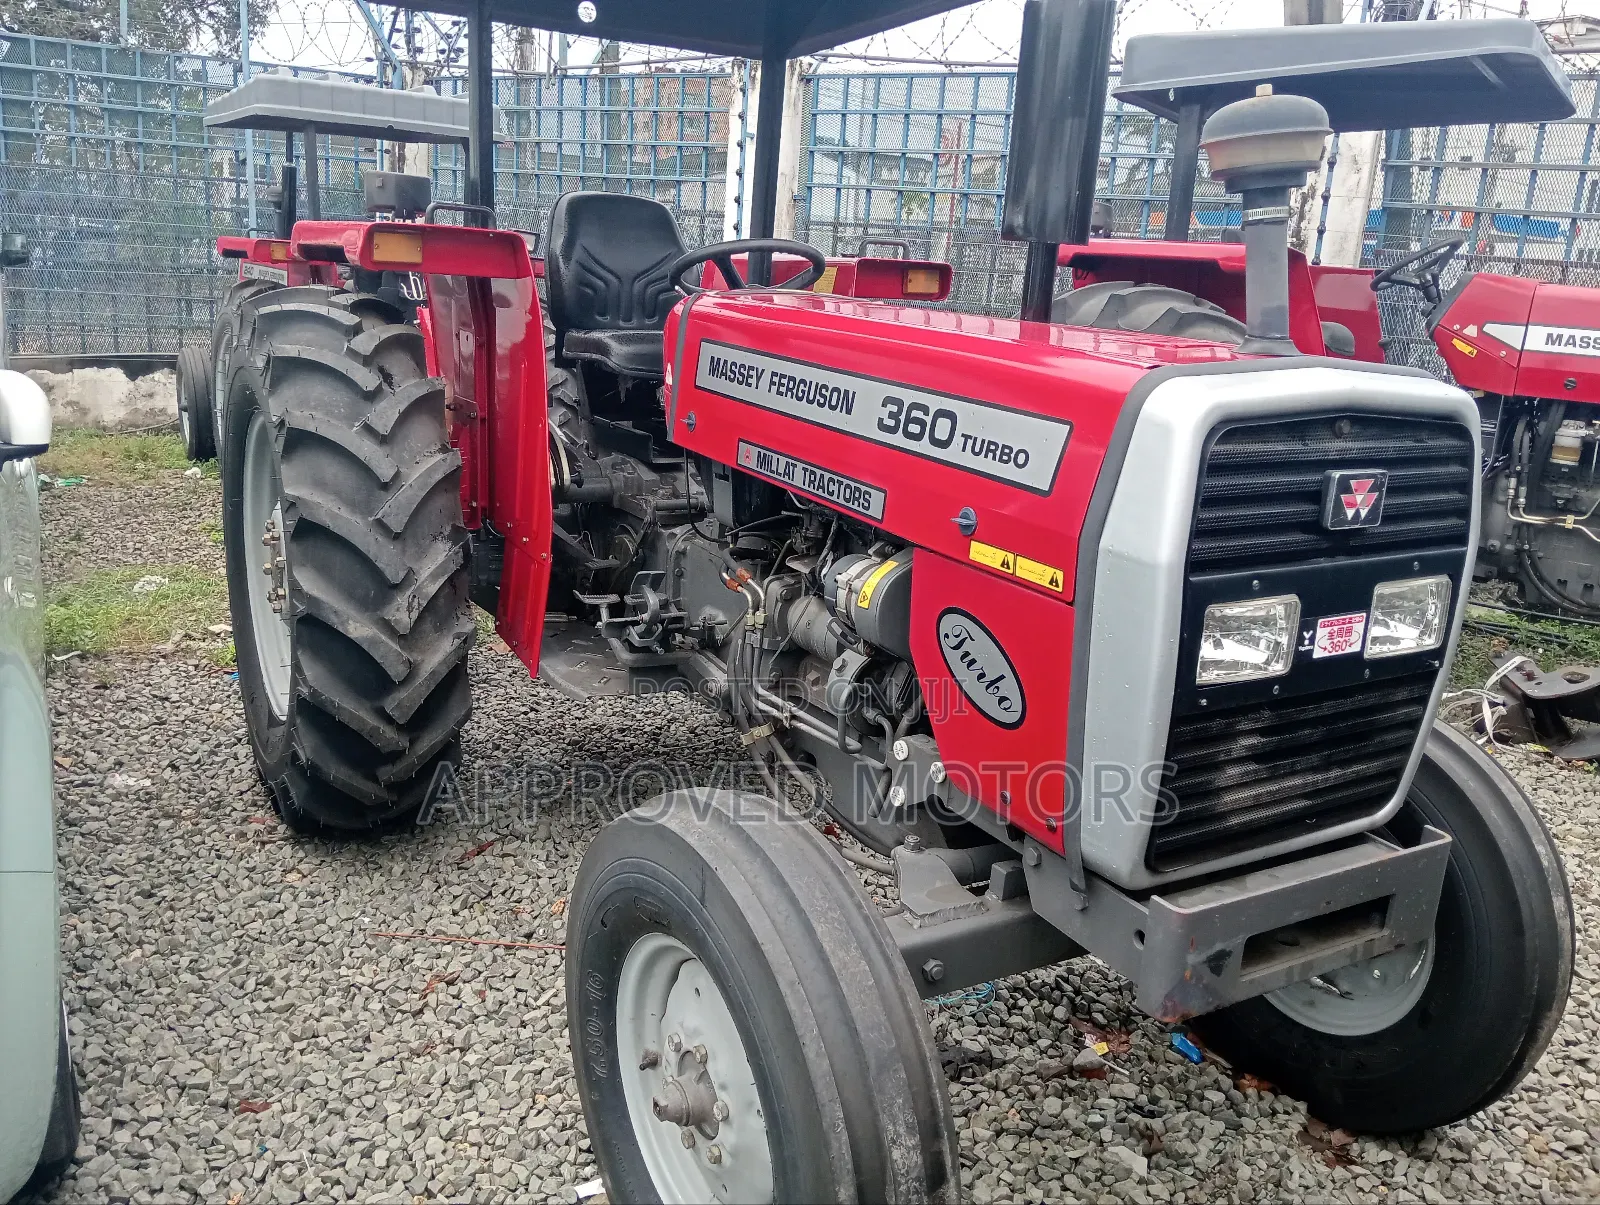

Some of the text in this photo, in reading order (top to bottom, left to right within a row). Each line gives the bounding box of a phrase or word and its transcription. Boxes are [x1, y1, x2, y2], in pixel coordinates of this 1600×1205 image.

[708, 355, 1030, 469] MASSEY FERGUSON 360 TURBO
[756, 450, 872, 512] MILLAT TRACTORS
[944, 624, 1019, 713] Turbo
